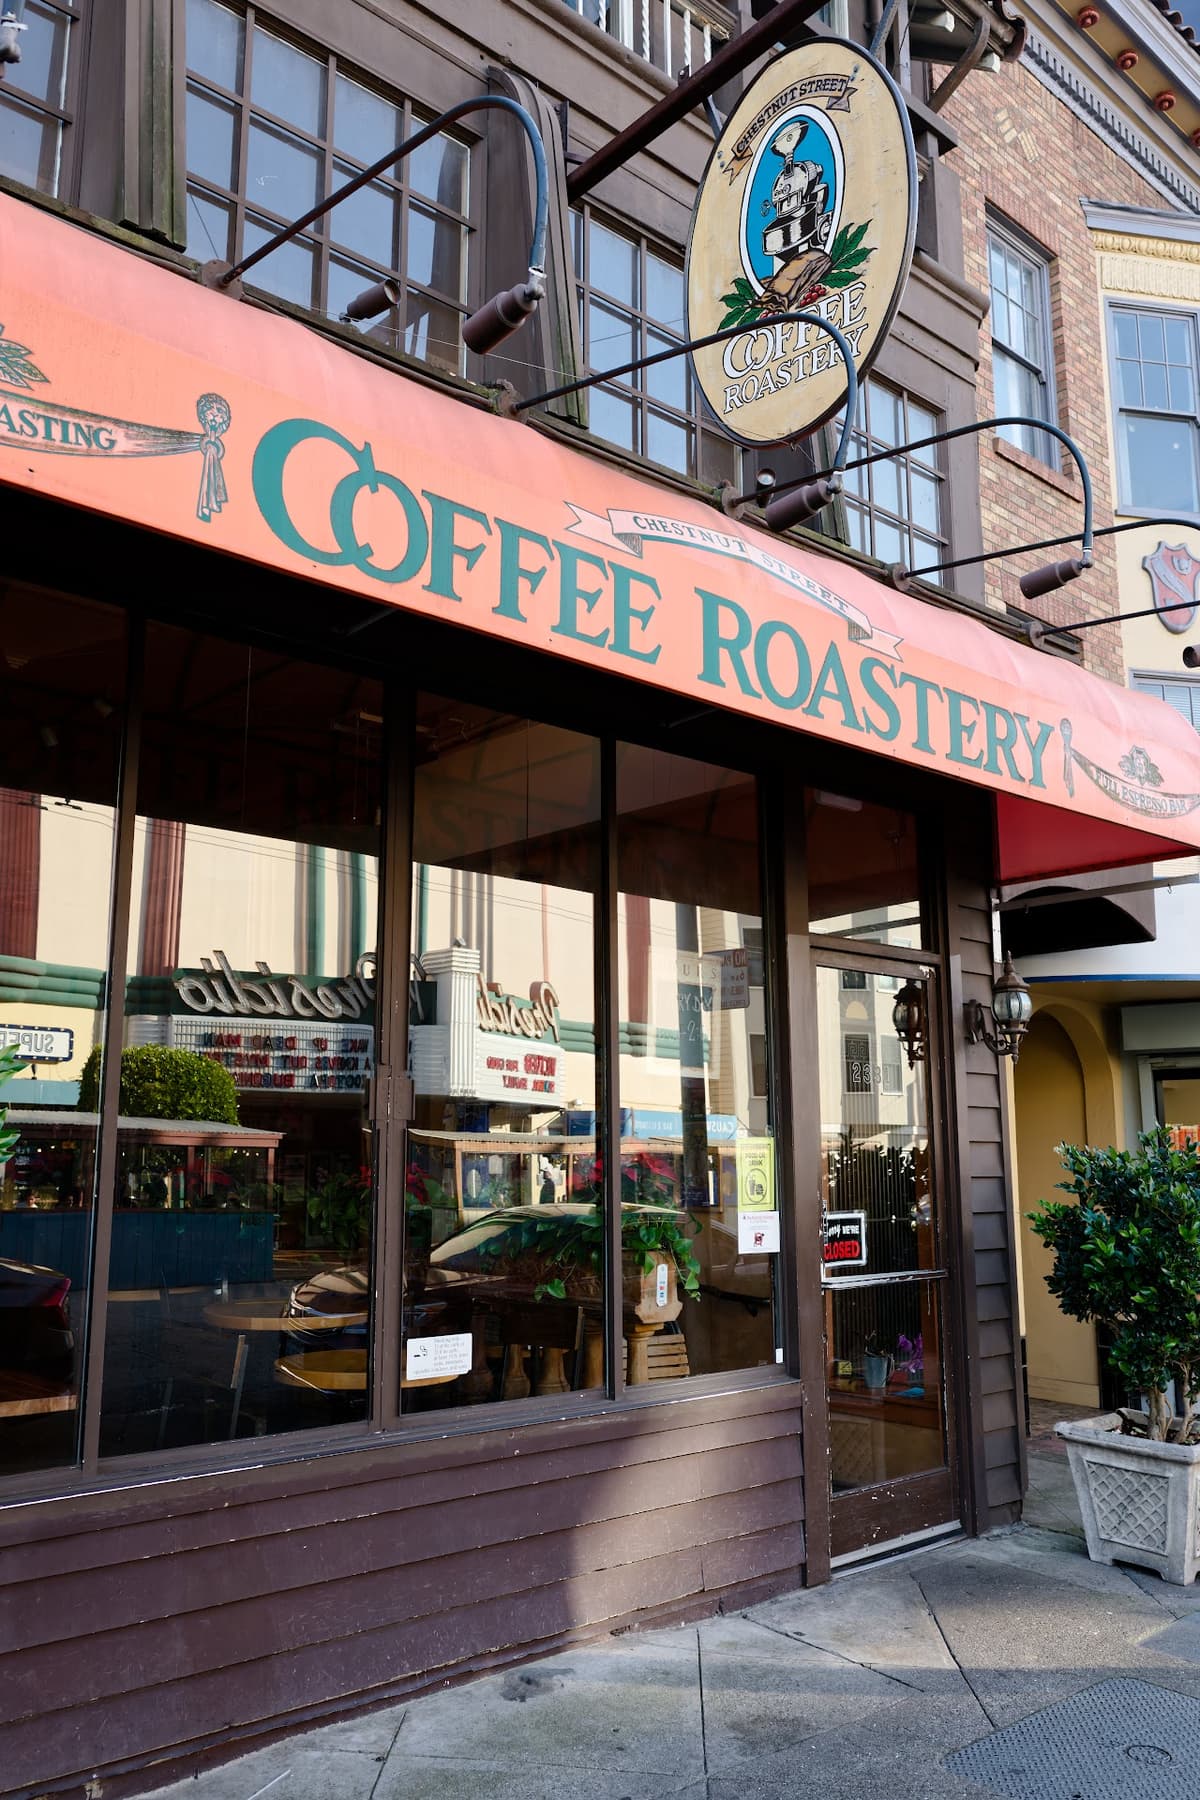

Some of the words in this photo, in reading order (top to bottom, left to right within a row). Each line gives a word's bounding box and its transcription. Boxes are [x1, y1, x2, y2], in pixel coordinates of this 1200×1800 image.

[736, 87, 799, 152] CHESTNUT
[799, 78, 848, 97] STREET
[722, 282, 867, 379] COFFEE
[723, 323, 869, 414] ROASTERY
[252, 418, 663, 665] COFFEE
[694, 586, 1055, 789] ROASTERY
[632, 515, 747, 553] CHESTNUT
[760, 553, 850, 614] STREET
[824, 1240, 861, 1260] CLOSED
